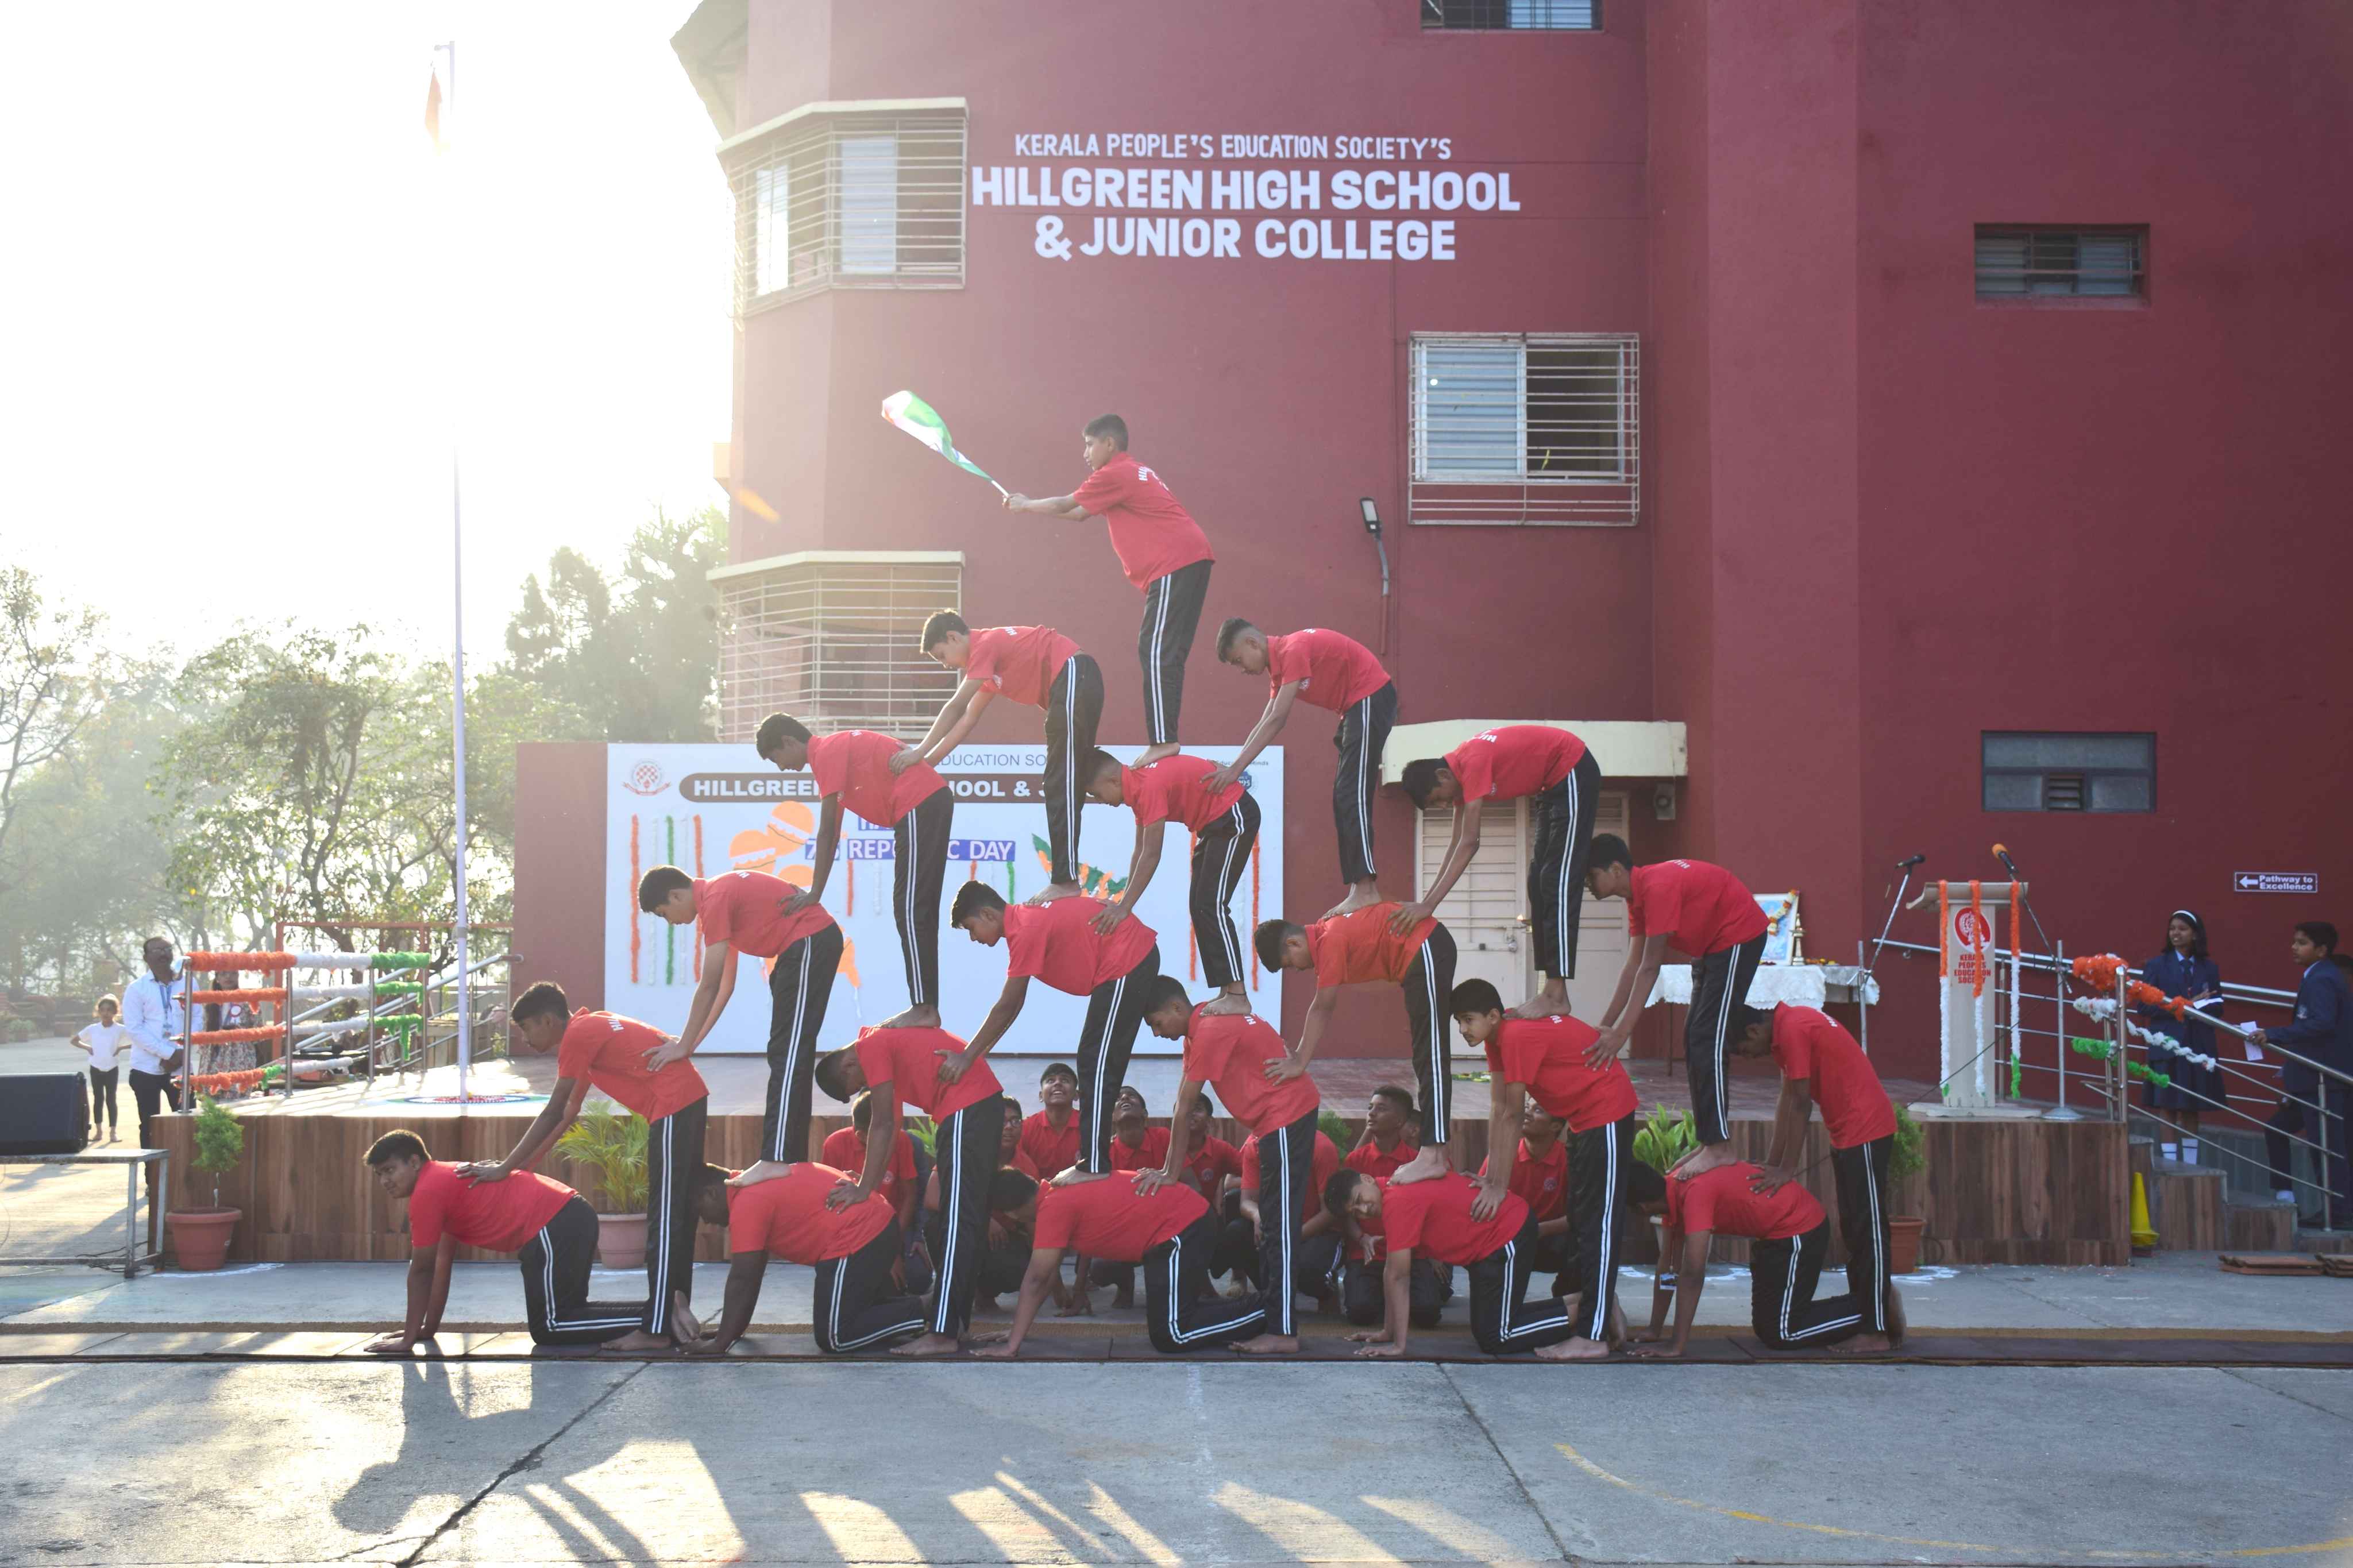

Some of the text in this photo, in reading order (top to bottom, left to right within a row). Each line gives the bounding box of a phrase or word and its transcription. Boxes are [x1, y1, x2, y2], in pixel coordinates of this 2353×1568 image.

[1015, 133, 1451, 160] KERALA PEOPLE'S EDUCATION SOCIETY'S
[971, 166, 1521, 211] HILLGREEN HIGH SCHOOL
[1034, 215, 1455, 261] & JUNIOR COLLEGE
[942, 754, 1020, 766] DUCATION
[1013, 781, 1031, 797] &
[970, 841, 1012, 860] DAY
[2259, 875, 2300, 884] Pathway
[2259, 882, 2313, 890] Excellence
